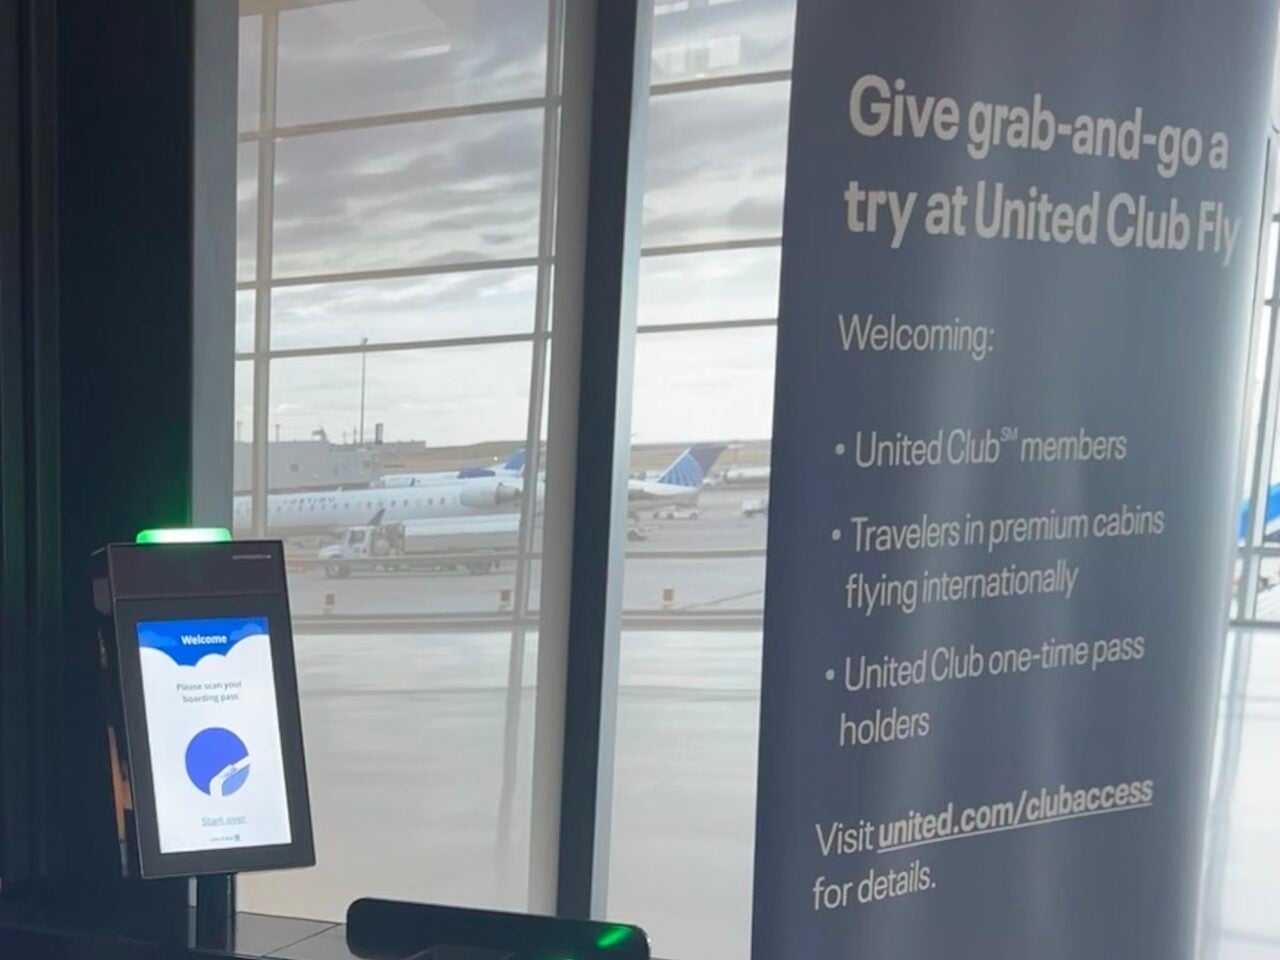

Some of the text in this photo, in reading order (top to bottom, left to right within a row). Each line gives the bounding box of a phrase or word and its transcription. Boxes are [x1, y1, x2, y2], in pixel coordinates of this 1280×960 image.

[848, 74, 1229, 179] Give grab-and-go a
[844, 180, 1242, 267] try at United Club Fly
[837, 313, 995, 361] Welcoming:
[855, 430, 942, 468] United
[1020, 427, 1128, 463] members
[850, 504, 1166, 553] Travelers in premium cabins
[845, 559, 1080, 616] flying internationally
[180, 634, 228, 646] Welcome
[844, 634, 1146, 691] United Club one-time pass
[838, 708, 930, 746] holders
[815, 779, 1154, 856] Visit united.com/clubaccess
[812, 860, 937, 910] for details.
